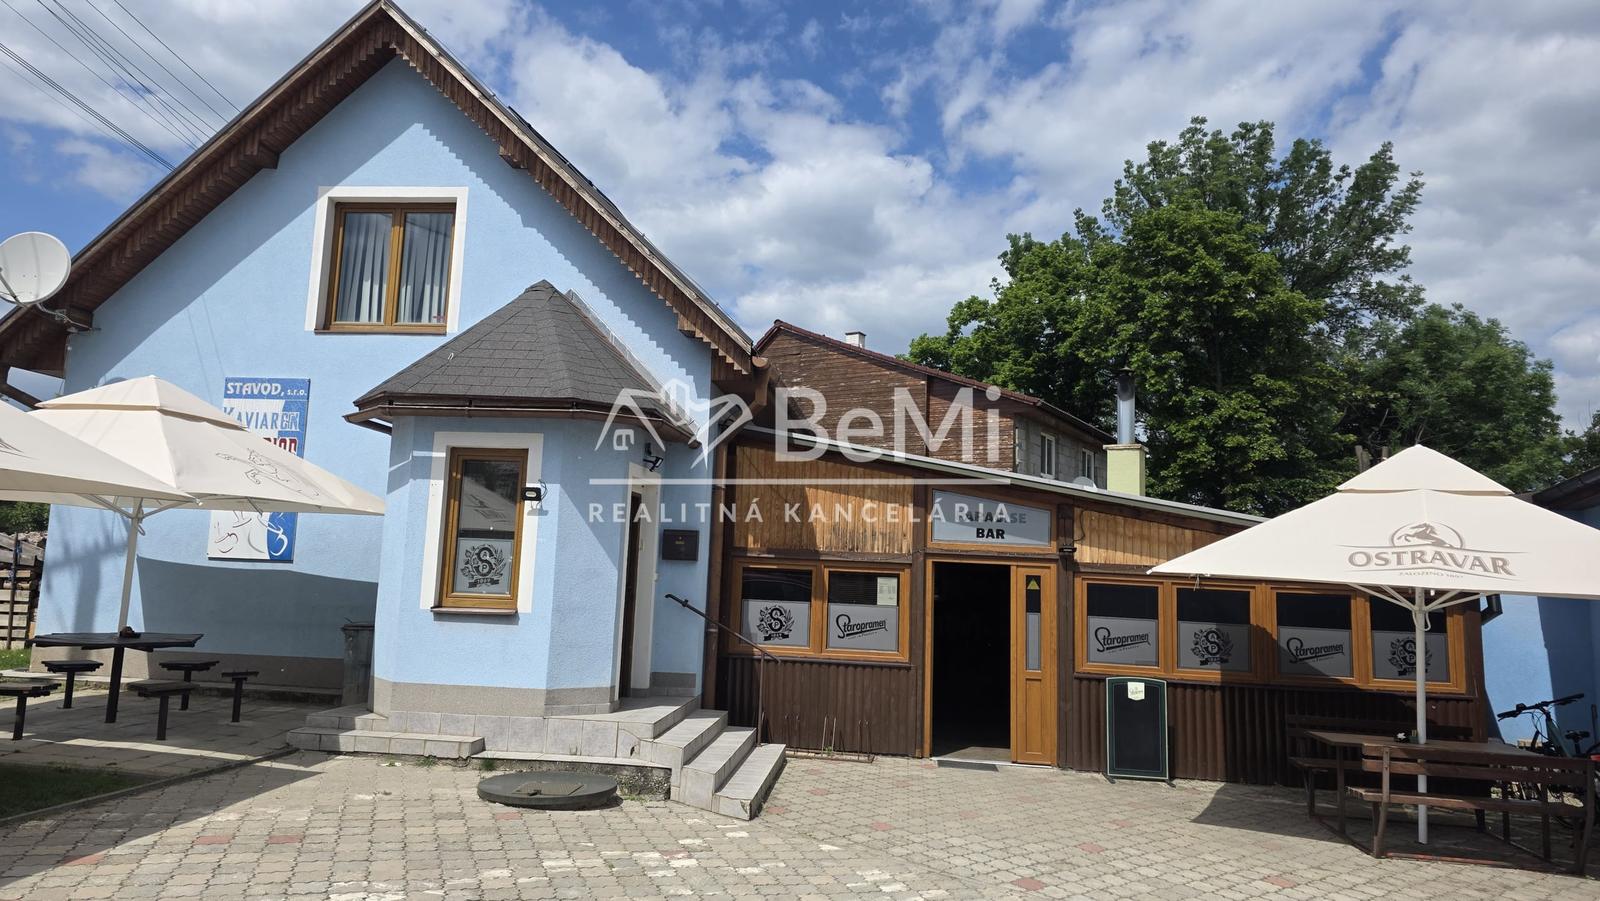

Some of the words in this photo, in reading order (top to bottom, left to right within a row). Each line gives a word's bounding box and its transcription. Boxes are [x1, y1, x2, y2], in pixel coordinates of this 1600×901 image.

[976, 527, 1005, 540] BAR
[1348, 550, 1517, 577] OSTRAVAR
[836, 613, 889, 639] Staropramen
[1094, 626, 1151, 652] Staropramen
[1286, 637, 1345, 664] Staropramen
